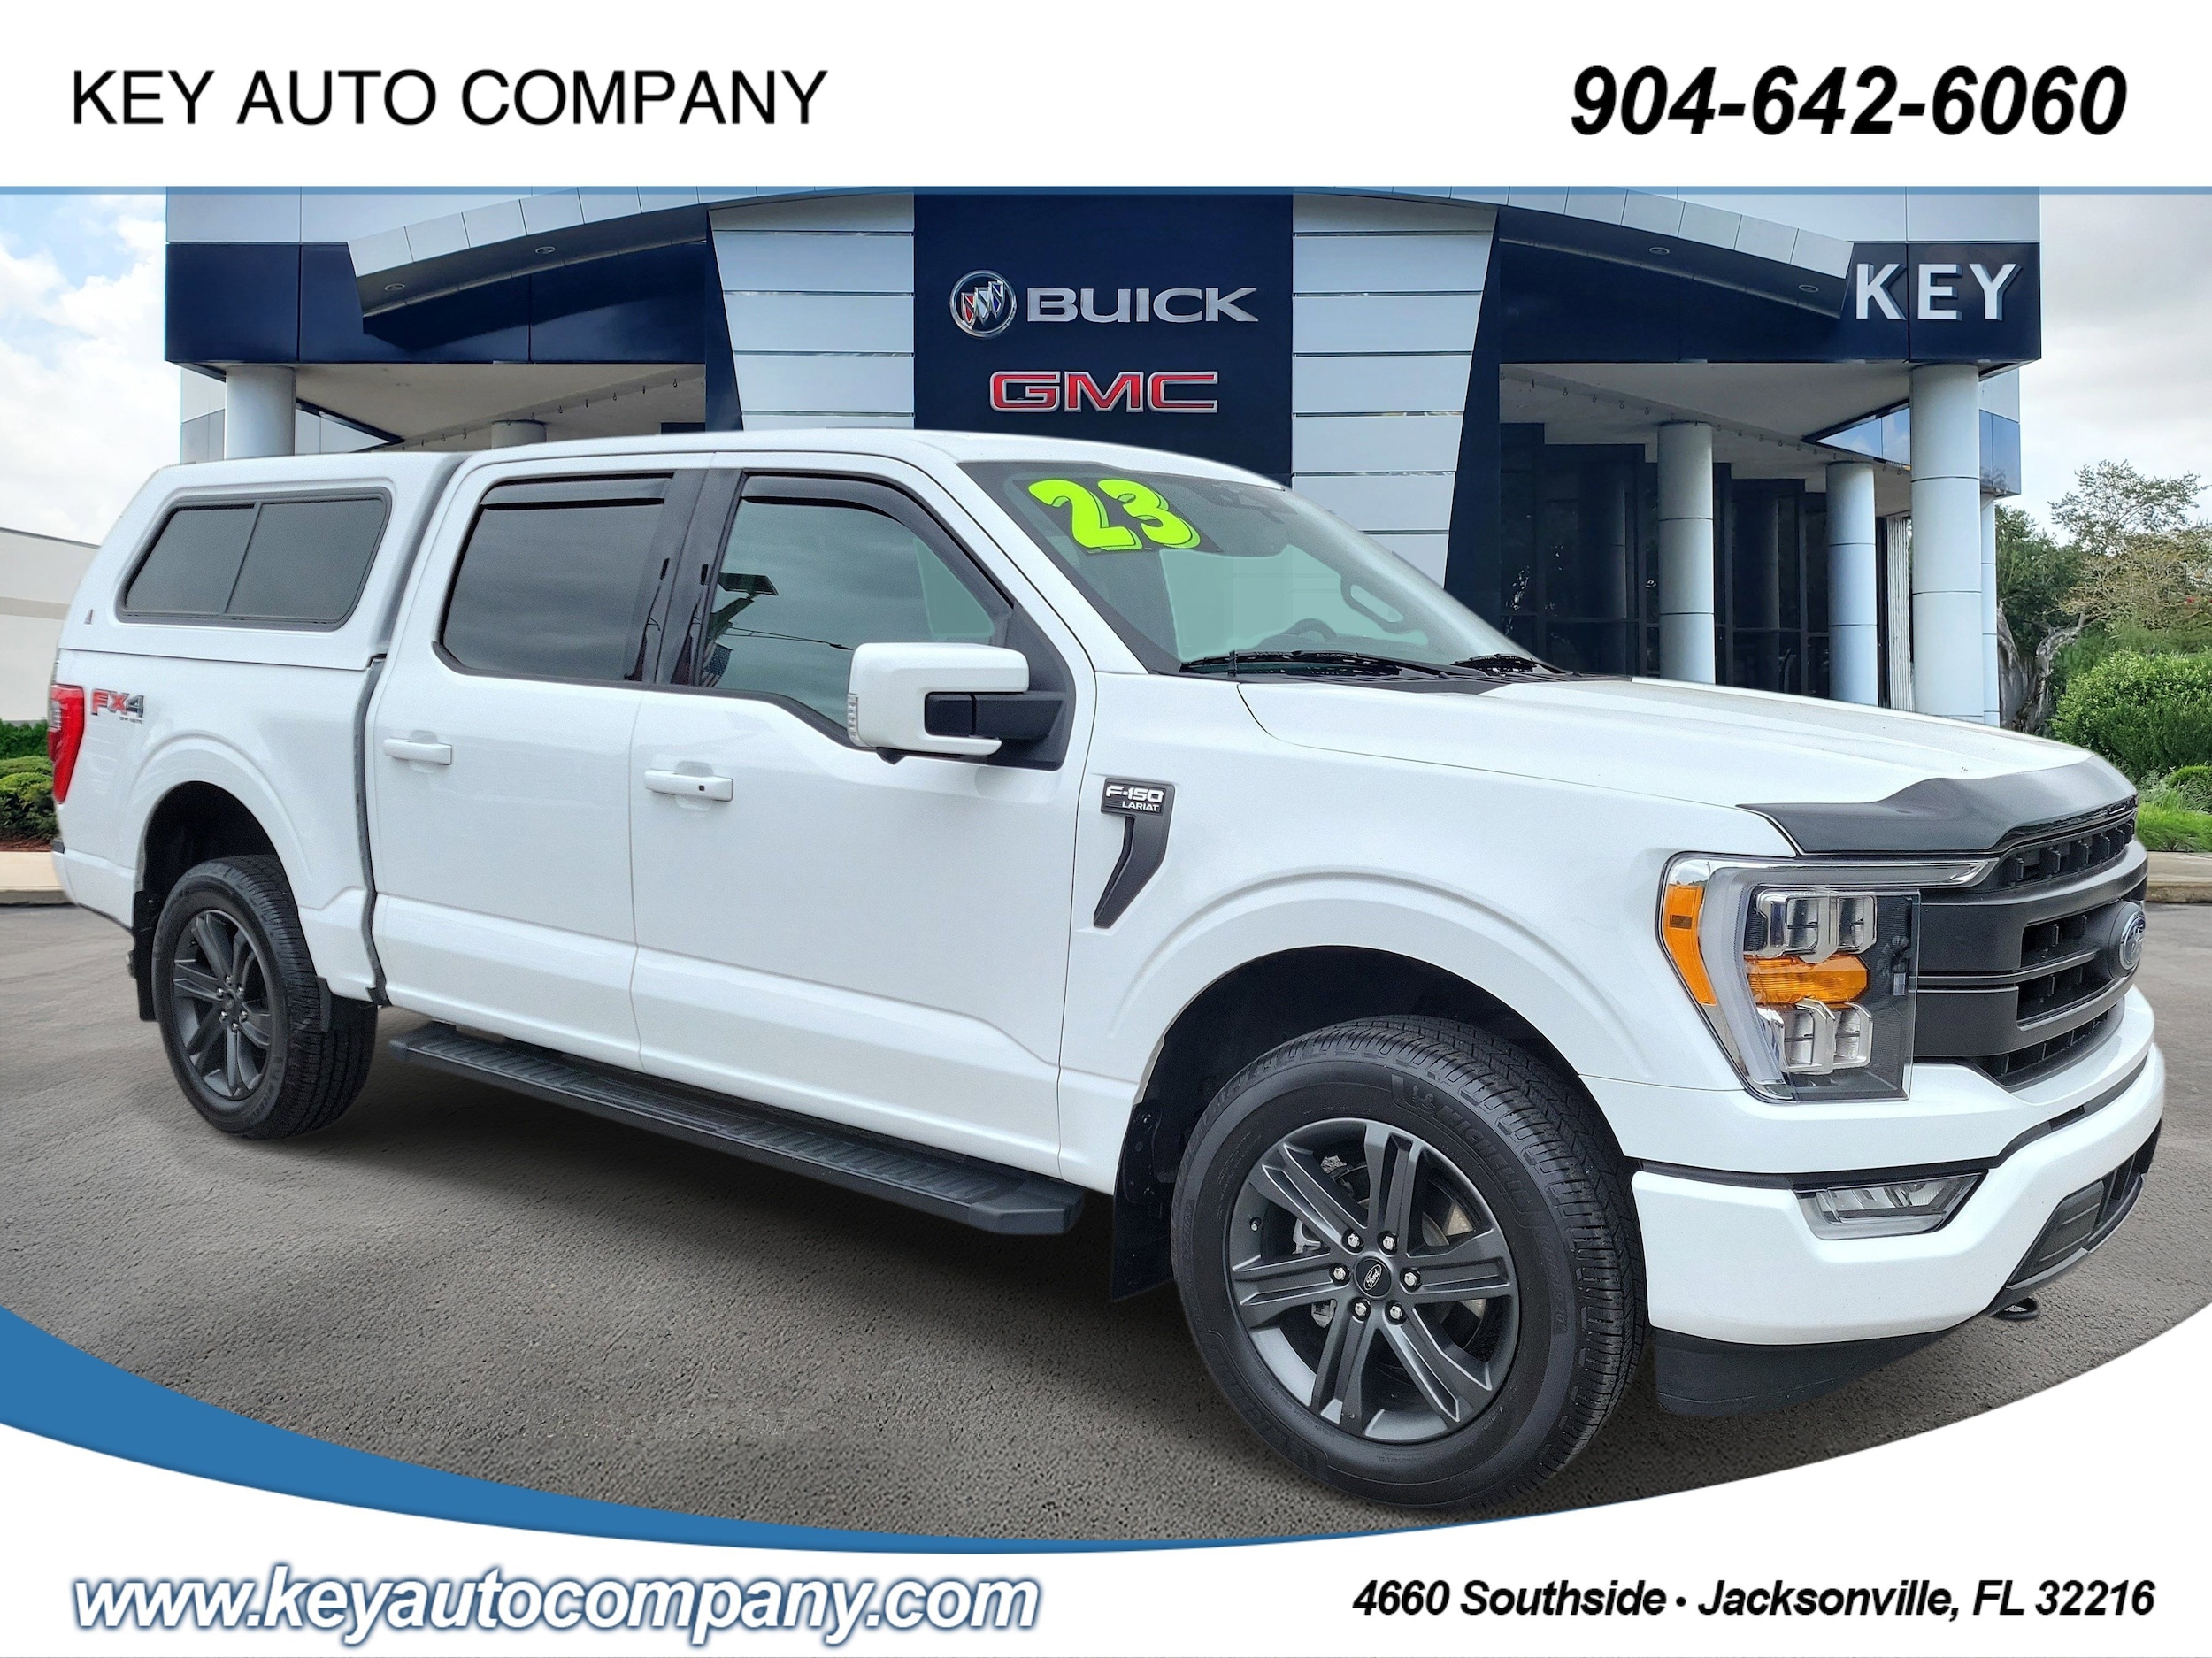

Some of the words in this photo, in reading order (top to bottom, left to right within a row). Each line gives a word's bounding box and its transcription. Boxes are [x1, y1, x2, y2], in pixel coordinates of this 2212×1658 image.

[1026, 287, 1259, 323] BUICK
[1856, 263, 2023, 320] KEY
[989, 370, 1218, 413] GMC
[1028, 479, 1201, 550] 23
[91, 688, 144, 718] FX4
[1105, 785, 1164, 803] F-150
[1122, 801, 1160, 812] LARIAT
[1365, 1268, 1379, 1287] Ford
